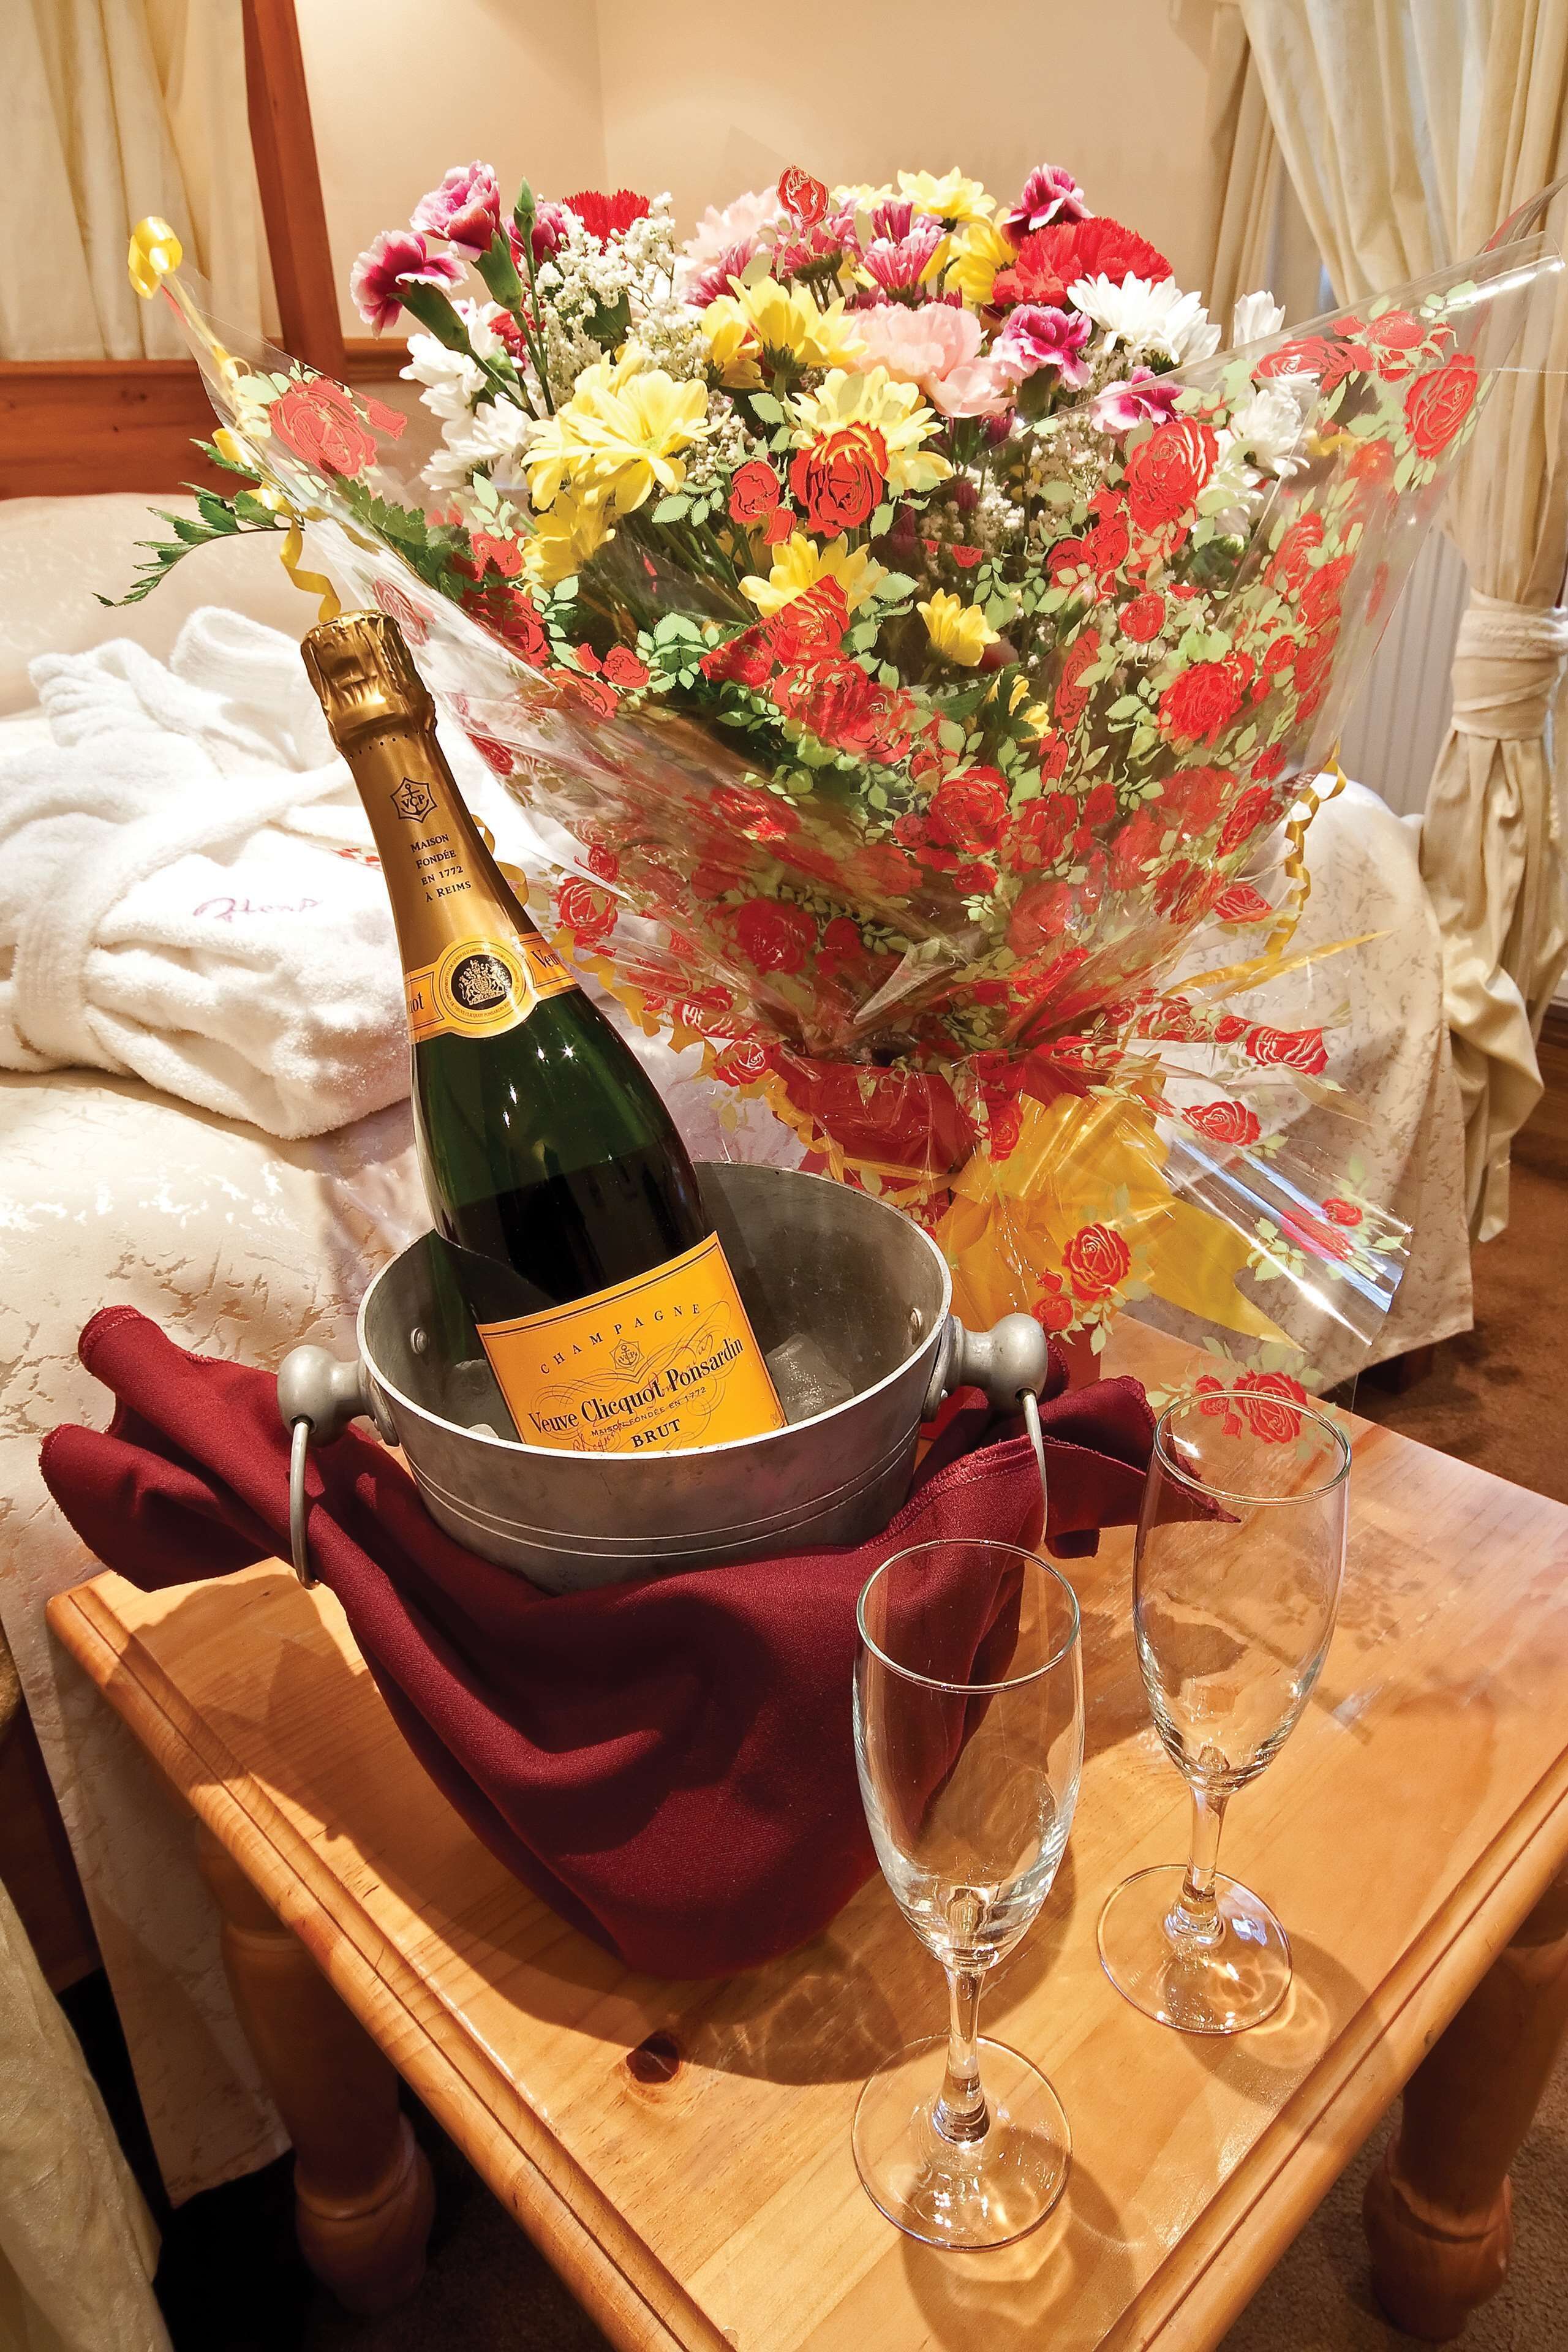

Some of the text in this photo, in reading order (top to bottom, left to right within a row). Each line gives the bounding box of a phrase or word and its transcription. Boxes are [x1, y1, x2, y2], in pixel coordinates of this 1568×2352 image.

[401, 794, 425, 809] VCP
[410, 834, 450, 853] MAISON
[415, 850, 456, 869] FONDÉE
[421, 865, 464, 886] EN 1772
[426, 881, 471, 902] À REIMS
[541, 1304, 699, 1374] CHAMPAGNE
[528, 1338, 743, 1433] Veuve Clicquot Ponsardin
[591, 1422, 625, 1436] MAISON
[629, 1406, 665, 1425] FONDÉE
[669, 1400, 681, 1409] EN
[684, 1386, 706, 1401] 1772
[630, 1419, 680, 1447] BRUT
